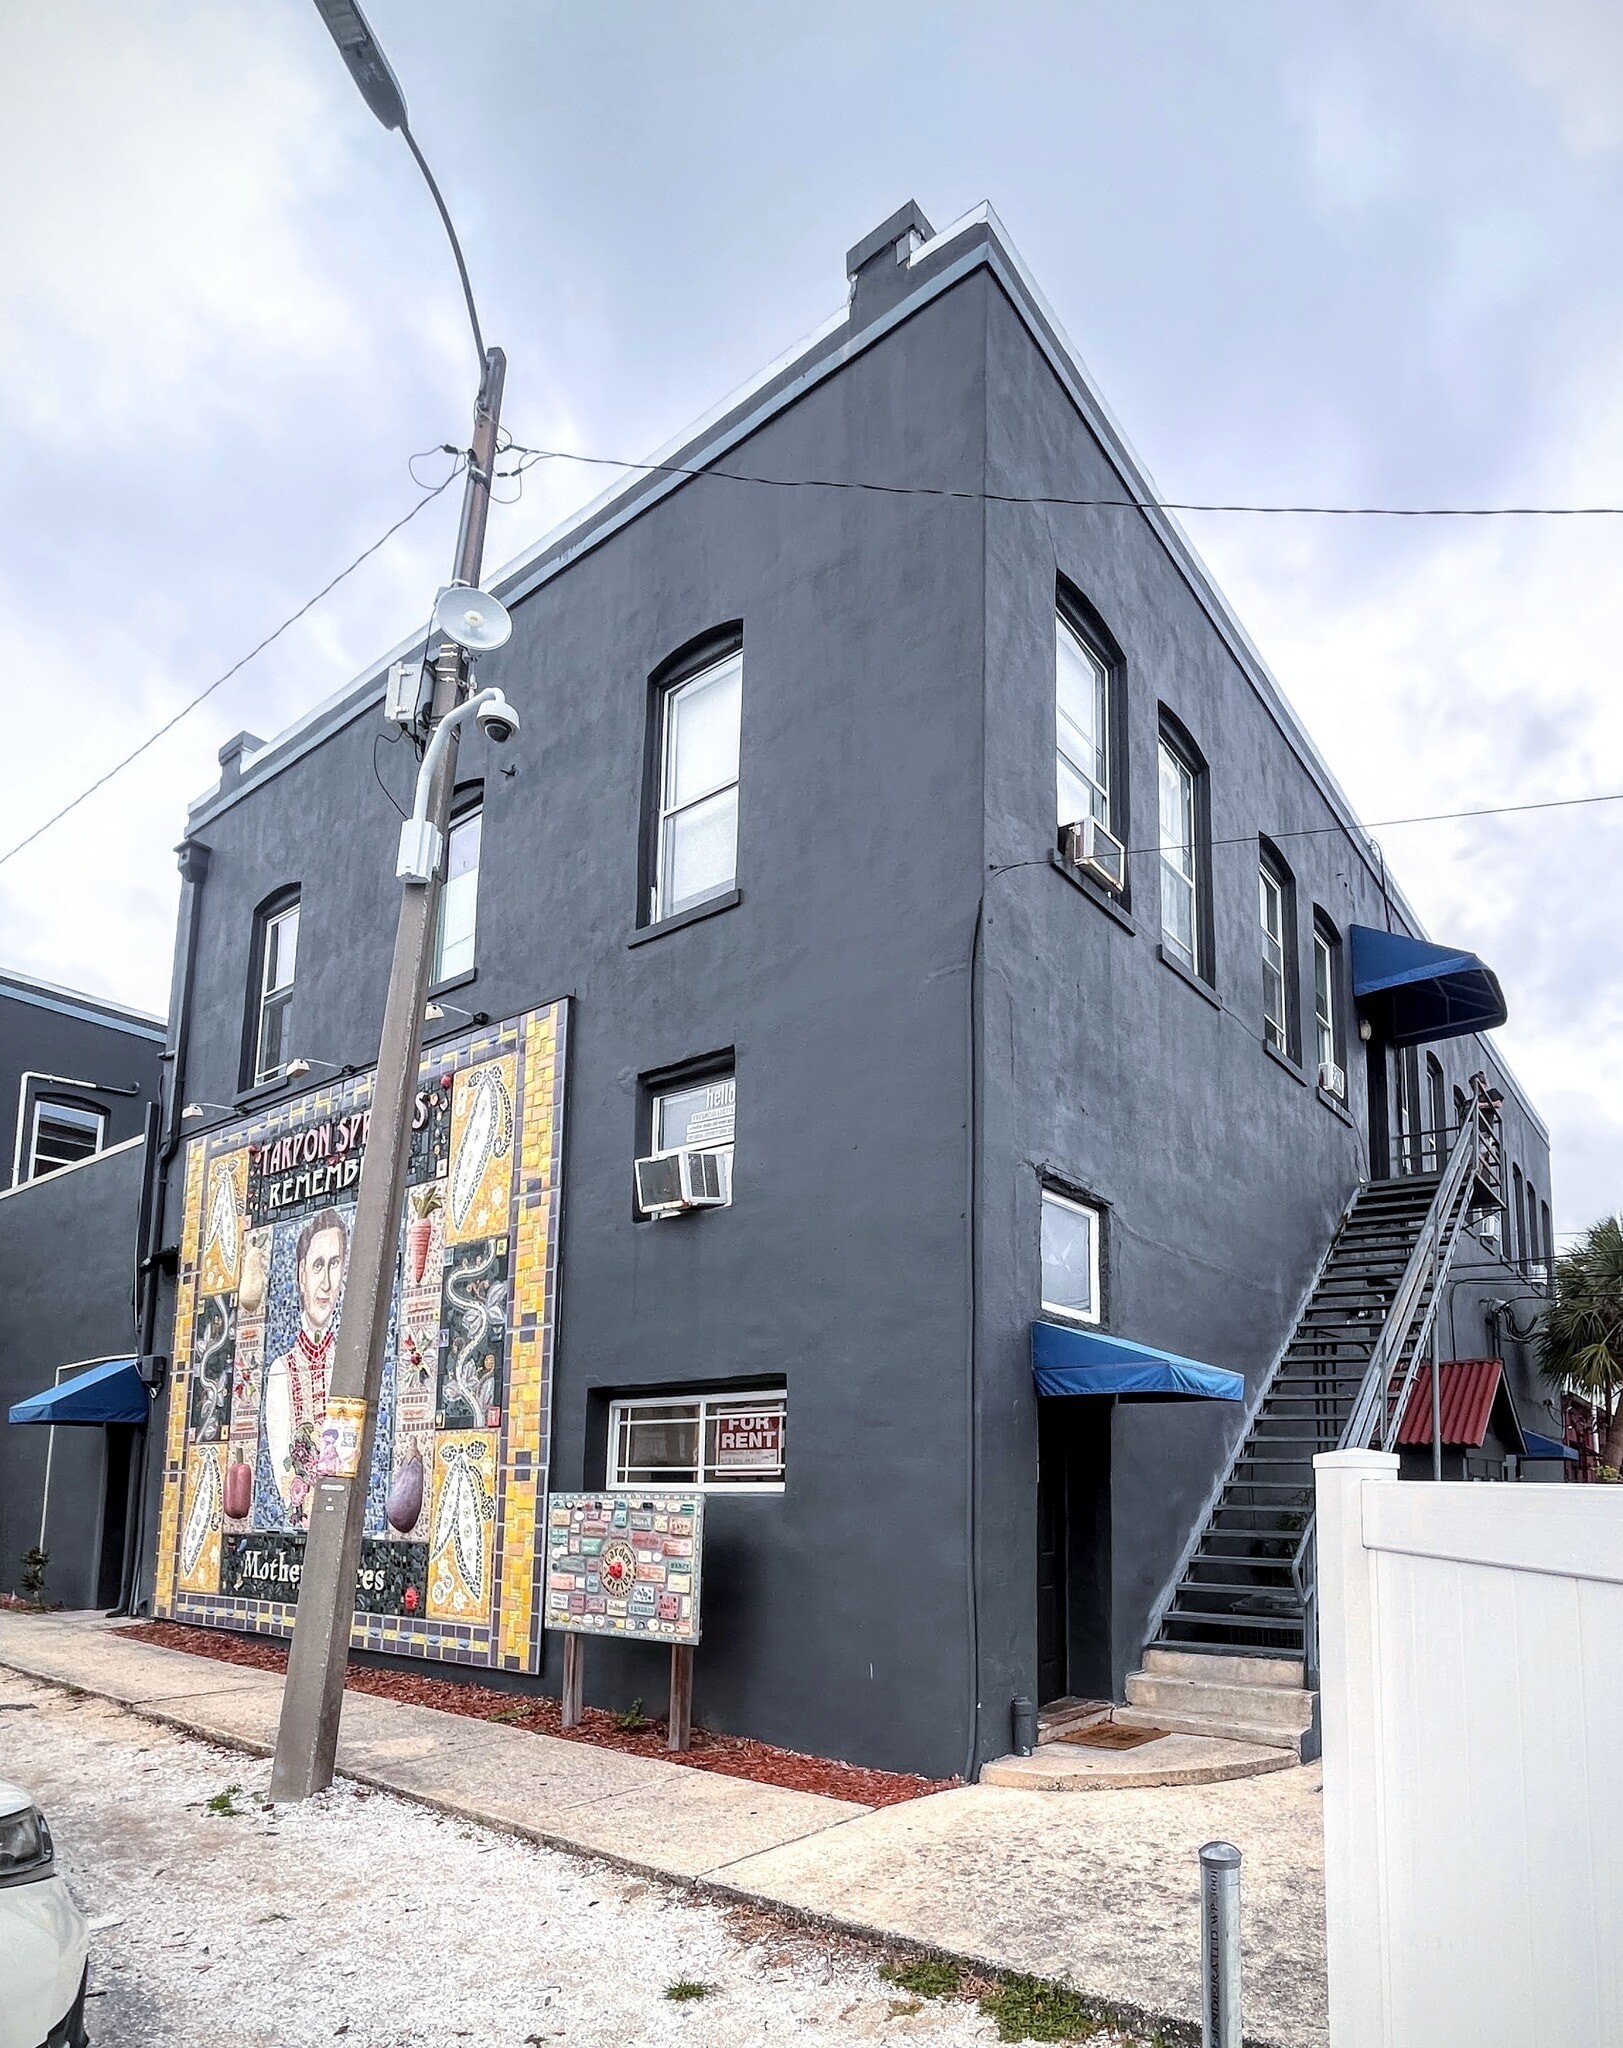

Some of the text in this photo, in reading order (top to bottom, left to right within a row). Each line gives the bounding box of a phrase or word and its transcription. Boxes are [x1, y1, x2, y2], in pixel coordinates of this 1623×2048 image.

[706, 1083, 735, 1109] hello
[261, 1122, 333, 1176] TARPON
[269, 1156, 366, 1209] REMEMB
[728, 1417, 770, 1431] FOR
[721, 1431, 777, 1449] RENT
[605, 1547, 632, 1567] Garden
